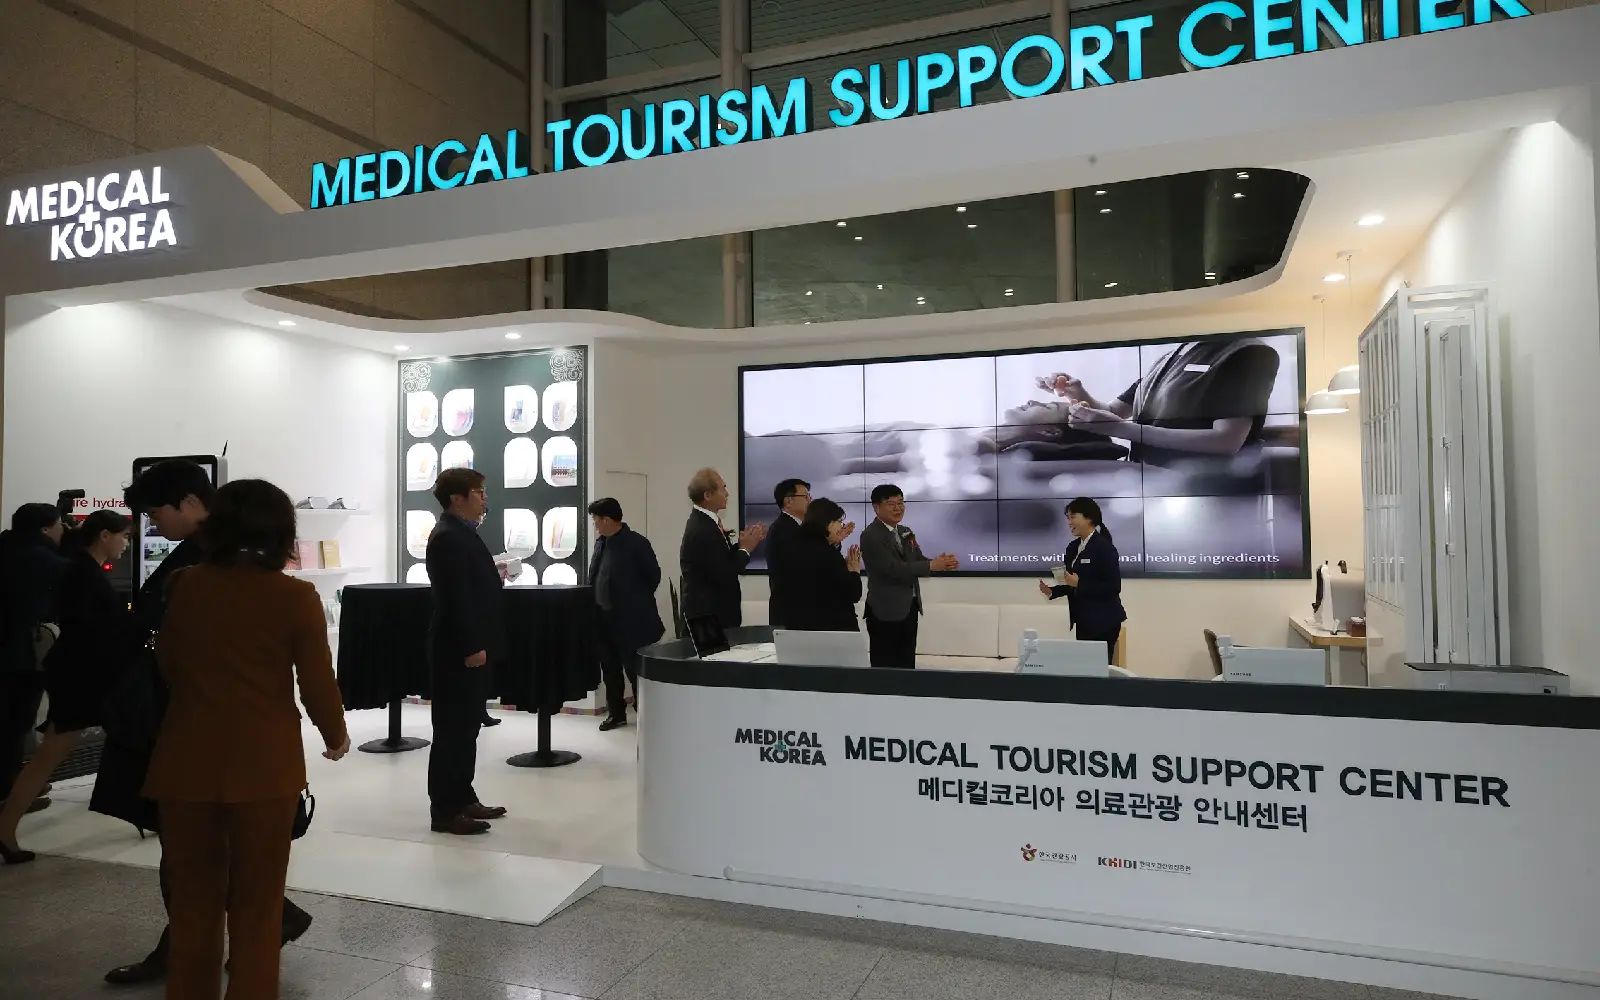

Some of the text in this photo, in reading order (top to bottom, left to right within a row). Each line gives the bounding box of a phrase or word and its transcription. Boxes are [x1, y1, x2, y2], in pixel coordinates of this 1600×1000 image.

[311, 129, 530, 209] MEDICAL
[546, 77, 808, 173] TOURISM
[829, 15, 1154, 128] SUPPORT
[5, 166, 170, 226] MEDICAL
[51, 208, 177, 261] KOREA
[93, 497, 128, 510] hydra
[968, 553, 1039, 562] Treatments
[1146, 553, 1197, 565] healing
[1199, 553, 1280, 565] ingredients
[735, 728, 822, 748] MEDICAL
[760, 746, 827, 766] KOREA
[844, 735, 1511, 808] MEDICAL TOURISM SUPPORT CENTER
[918, 777, 1309, 833] 메디컬코리아 의료관광 안내센터
[1098, 856, 1137, 870] KHIDI
